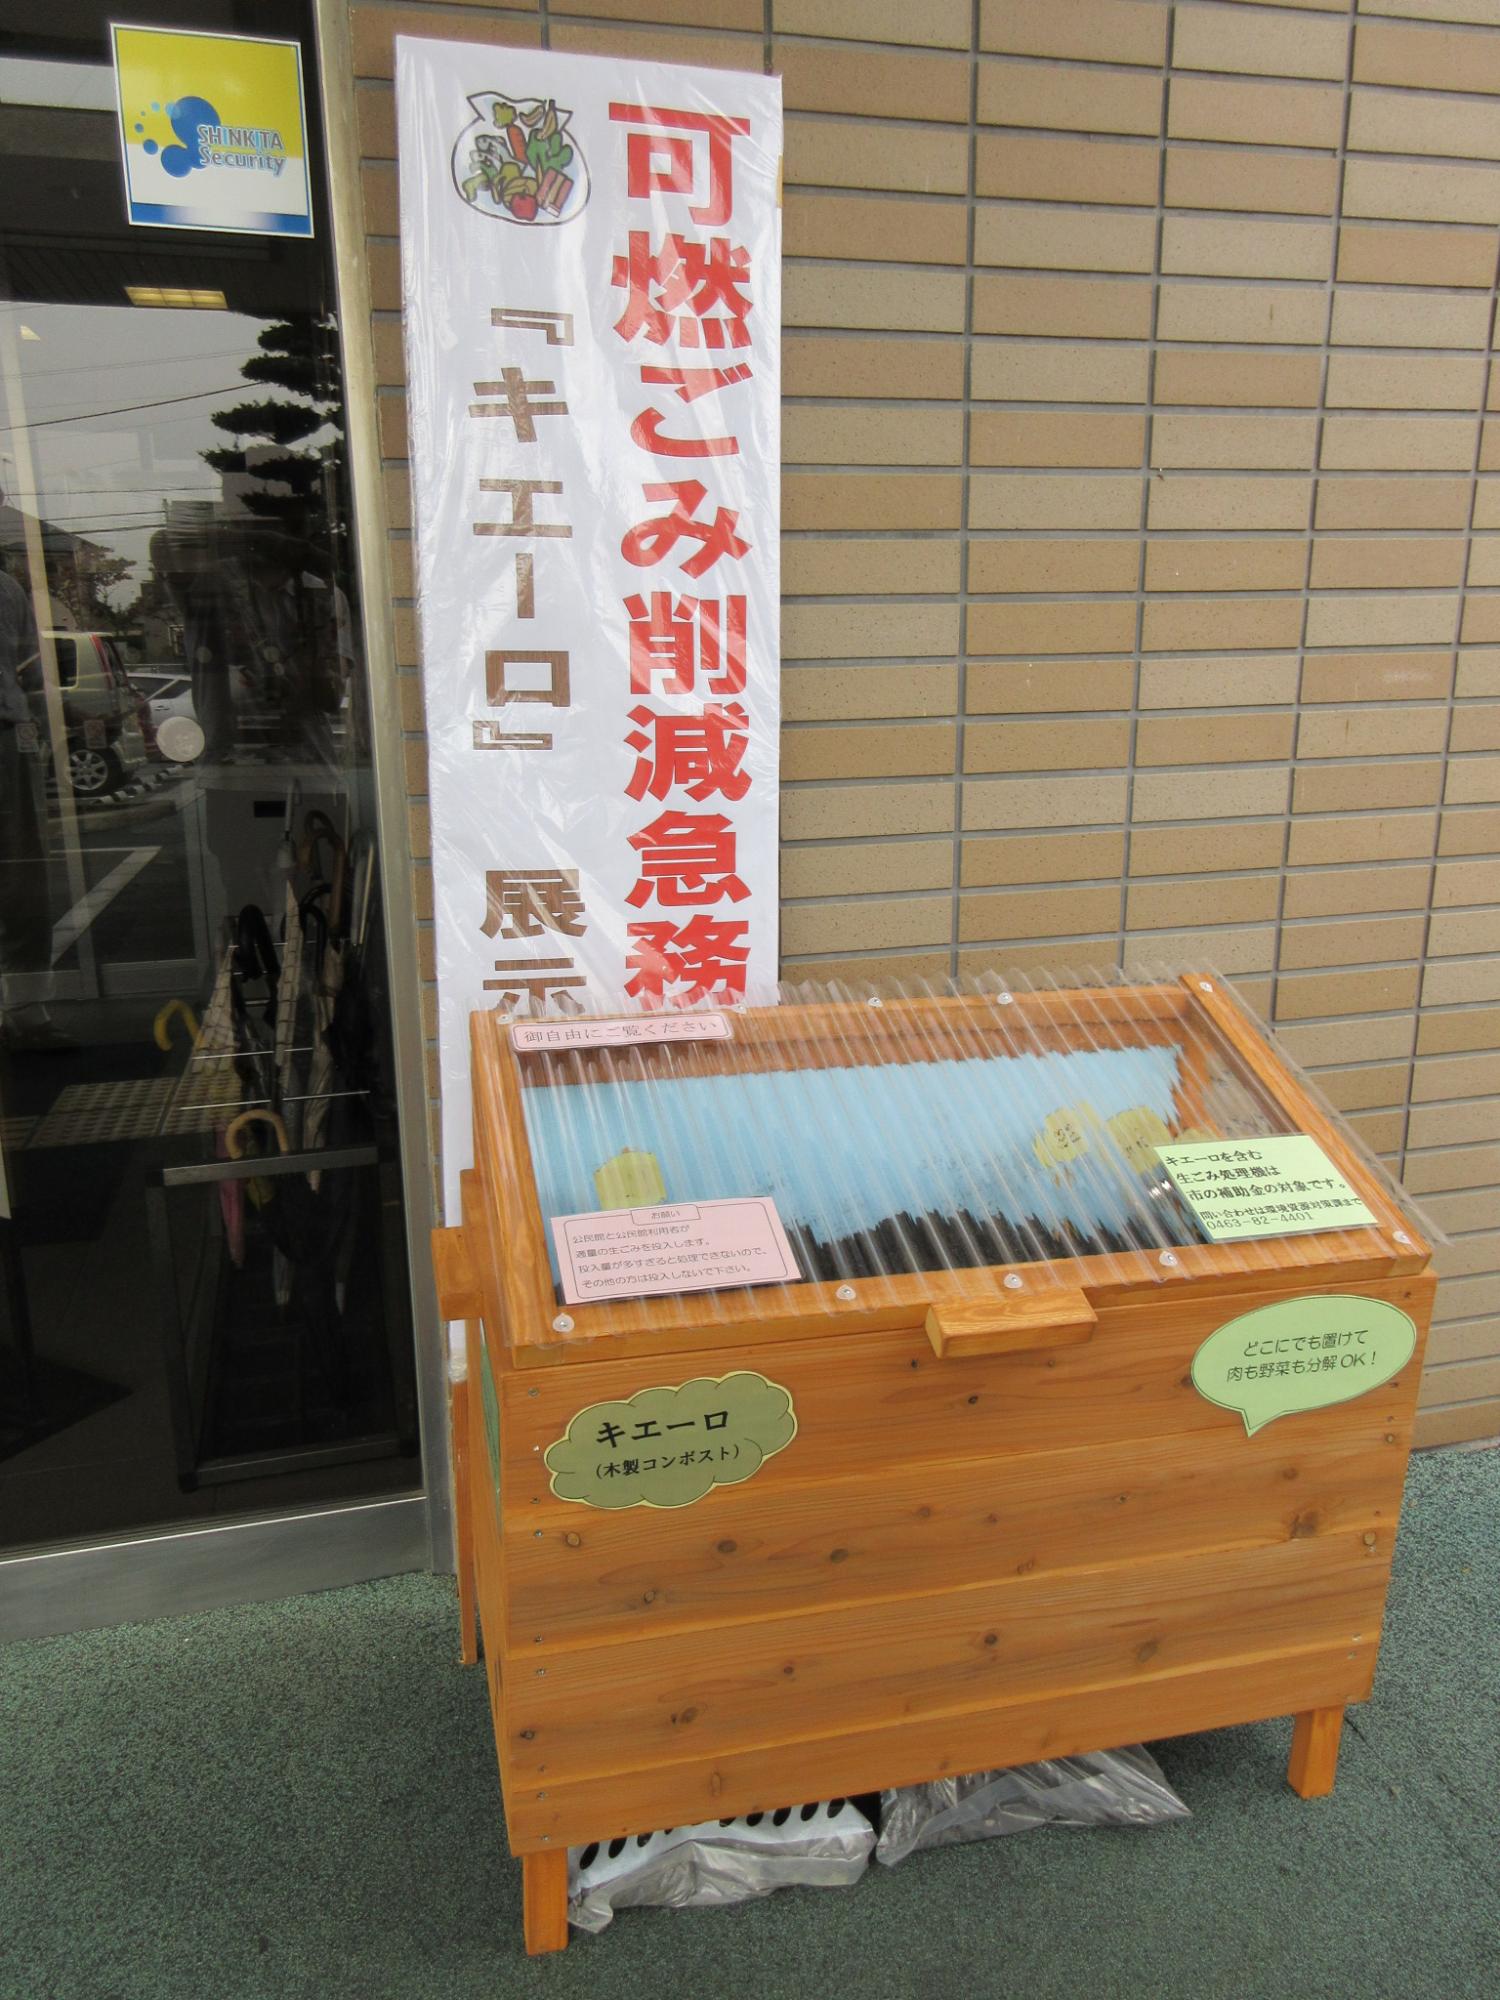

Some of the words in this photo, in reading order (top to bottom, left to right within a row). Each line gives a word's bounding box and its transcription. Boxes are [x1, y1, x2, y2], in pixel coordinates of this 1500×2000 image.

[197, 125, 283, 150] SHINKITA
[199, 146, 286, 176] Security
[609, 102, 753, 1010] 可燃ごみ削減急務
[524, 1022, 716, 1042] 御自由にご覧ください
[1165, 1150, 1263, 1166] キエーロを含む
[1176, 1166, 1280, 1184] 生ごみ処理機は
[1187, 1178, 1345, 1201] 市の補助金の対象です。
[1243, 1330, 1368, 1357] どこにでも置けて
[596, 1411, 728, 1448] キエーロ
